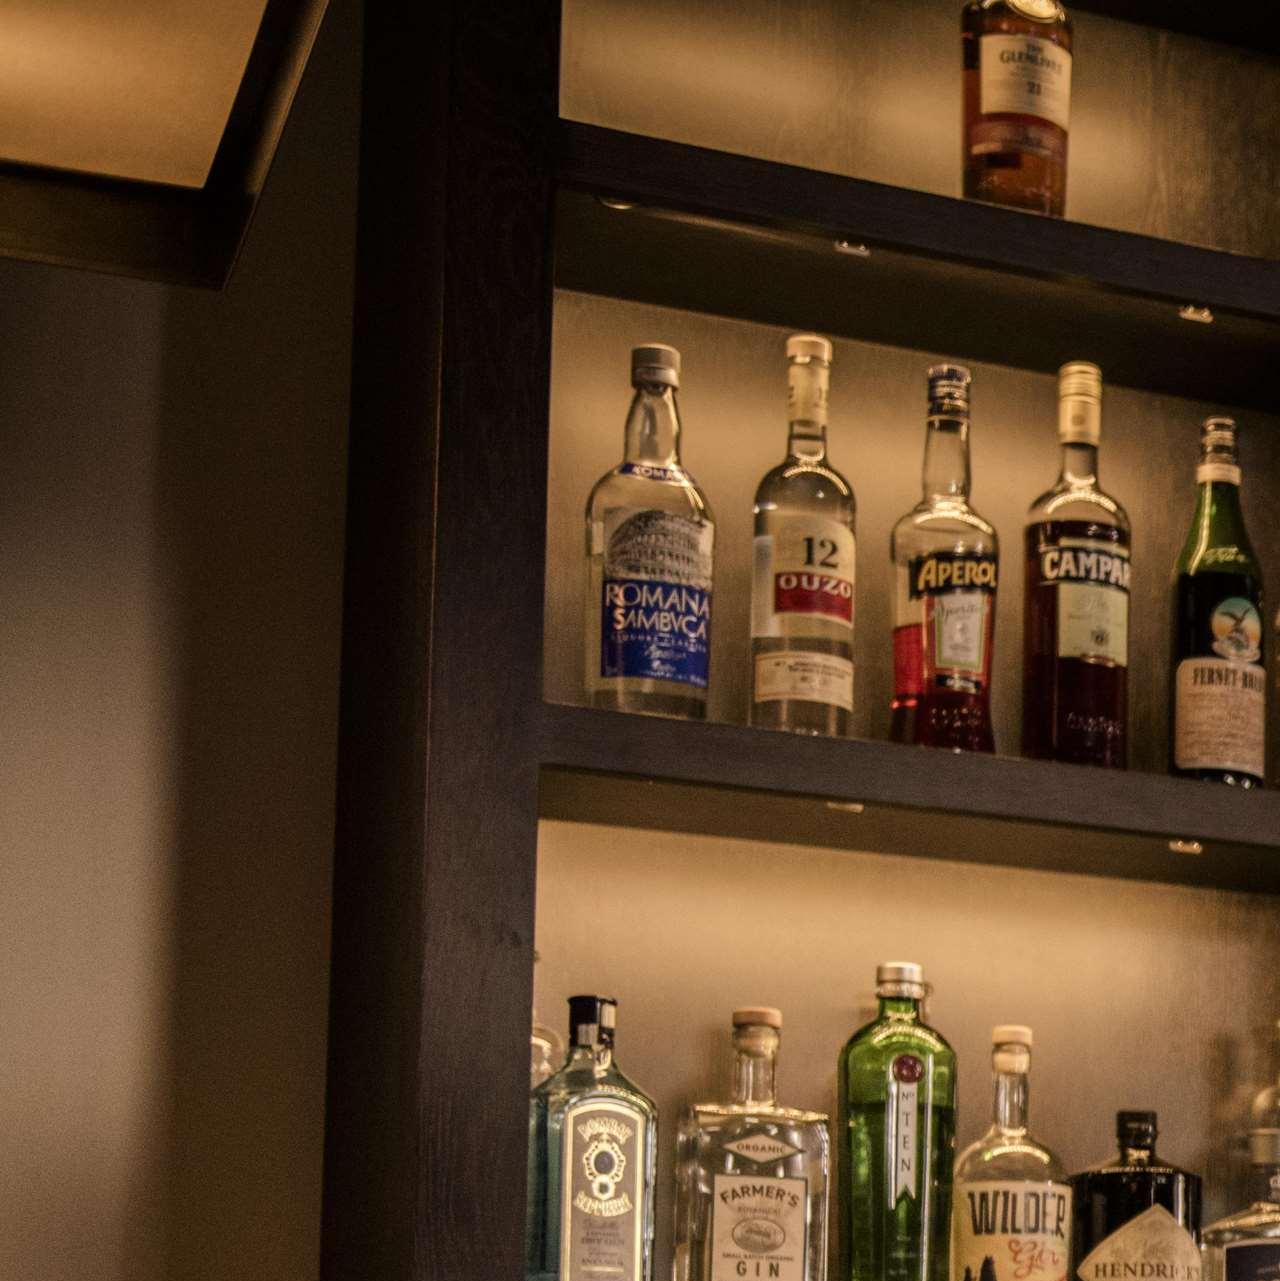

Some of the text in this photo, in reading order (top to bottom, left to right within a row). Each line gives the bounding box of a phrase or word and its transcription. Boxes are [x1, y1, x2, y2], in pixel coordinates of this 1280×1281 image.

[803, 537, 839, 570] 12
[778, 574, 852, 598] OUZO
[918, 559, 996, 590] APEROL
[1044, 551, 1131, 590] CAMPA
[605, 583, 710, 620] ROMANA
[736, 1143, 786, 1154] ORGANIC
[901, 1111, 911, 1172] TEN
[719, 1184, 800, 1208] FARMER'S
[968, 1190, 1066, 1239] WILDER
[736, 1259, 780, 1278] GIN
[1008, 1239, 1060, 1279] Gin
